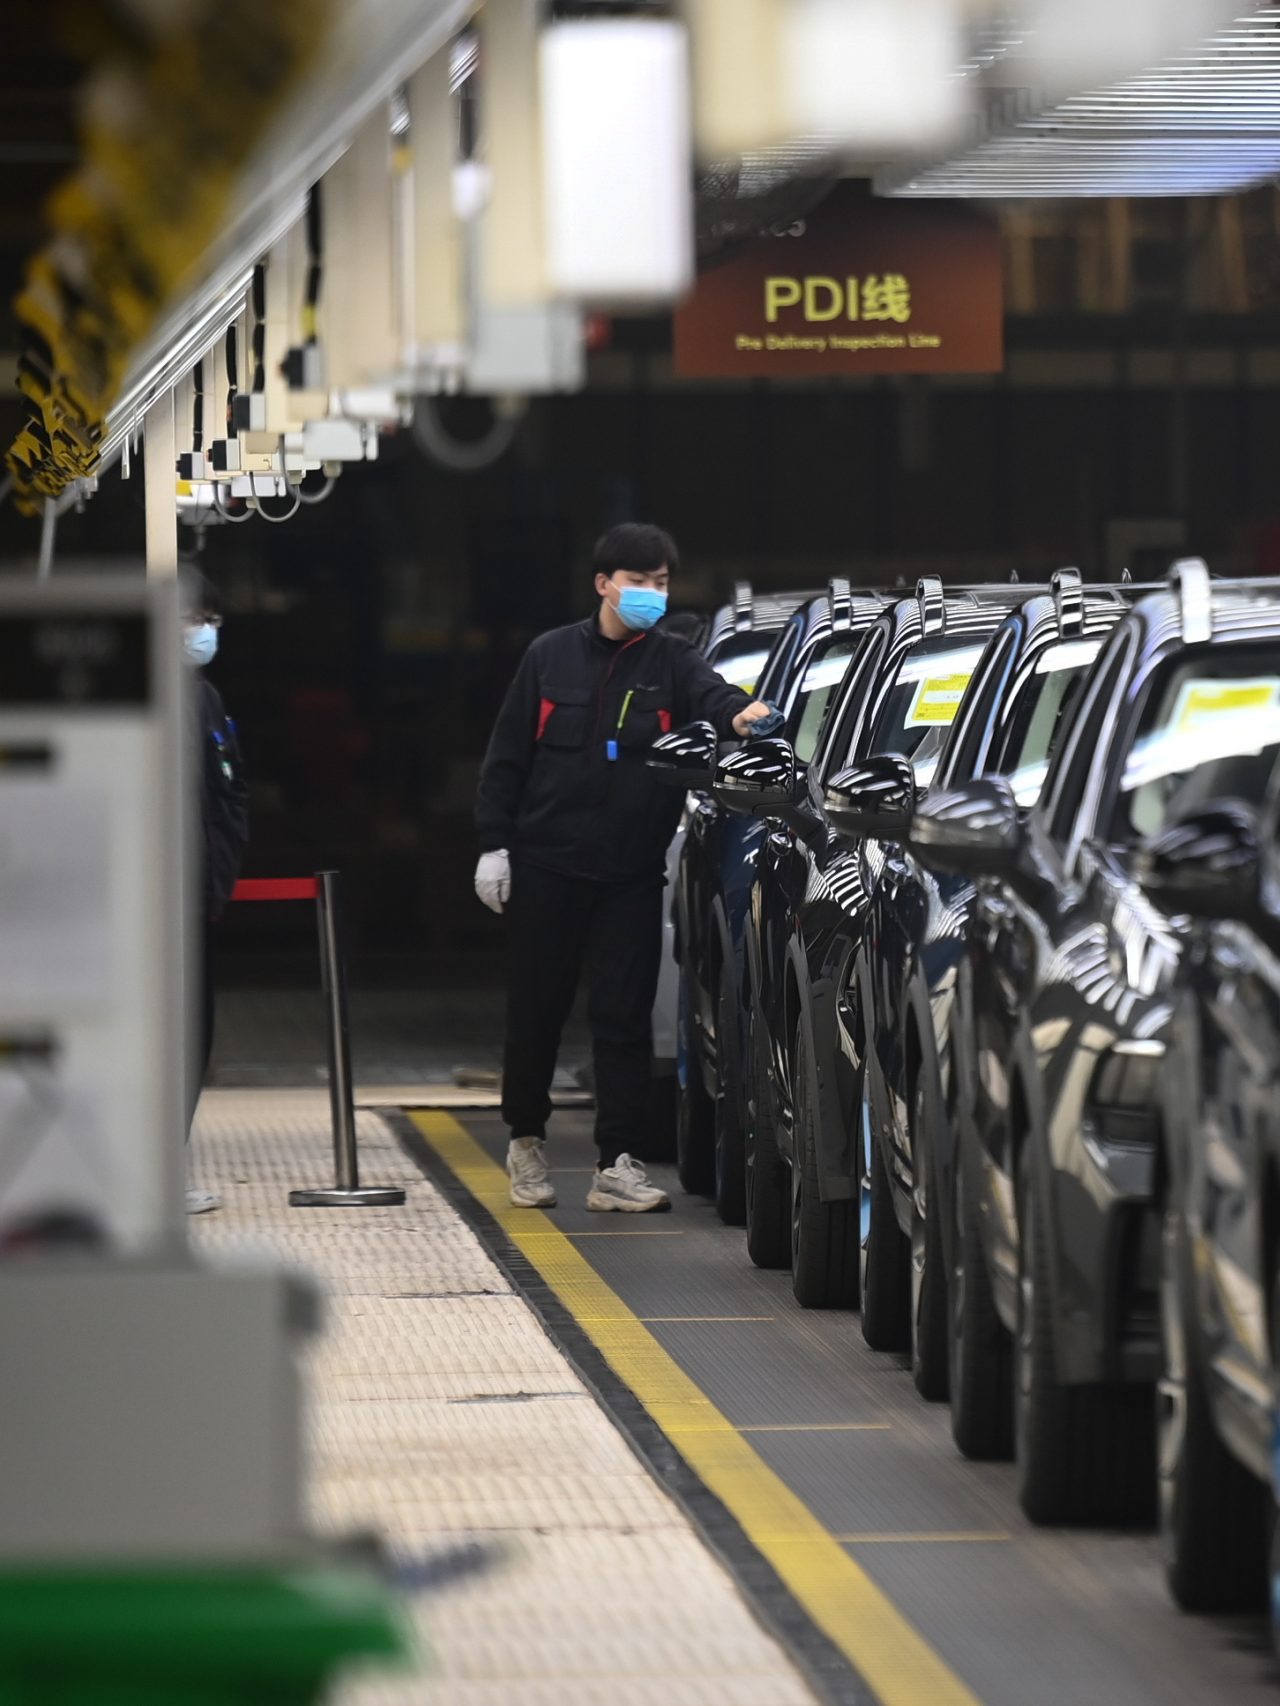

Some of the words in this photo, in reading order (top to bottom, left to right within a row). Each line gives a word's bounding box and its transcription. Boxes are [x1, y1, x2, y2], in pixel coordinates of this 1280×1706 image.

[765, 274, 911, 322] PDI线
[736, 335, 763, 349] Pre
[766, 335, 826, 351] Delivery
[829, 334, 906, 351] Inspection
[908, 333, 942, 348] Line
